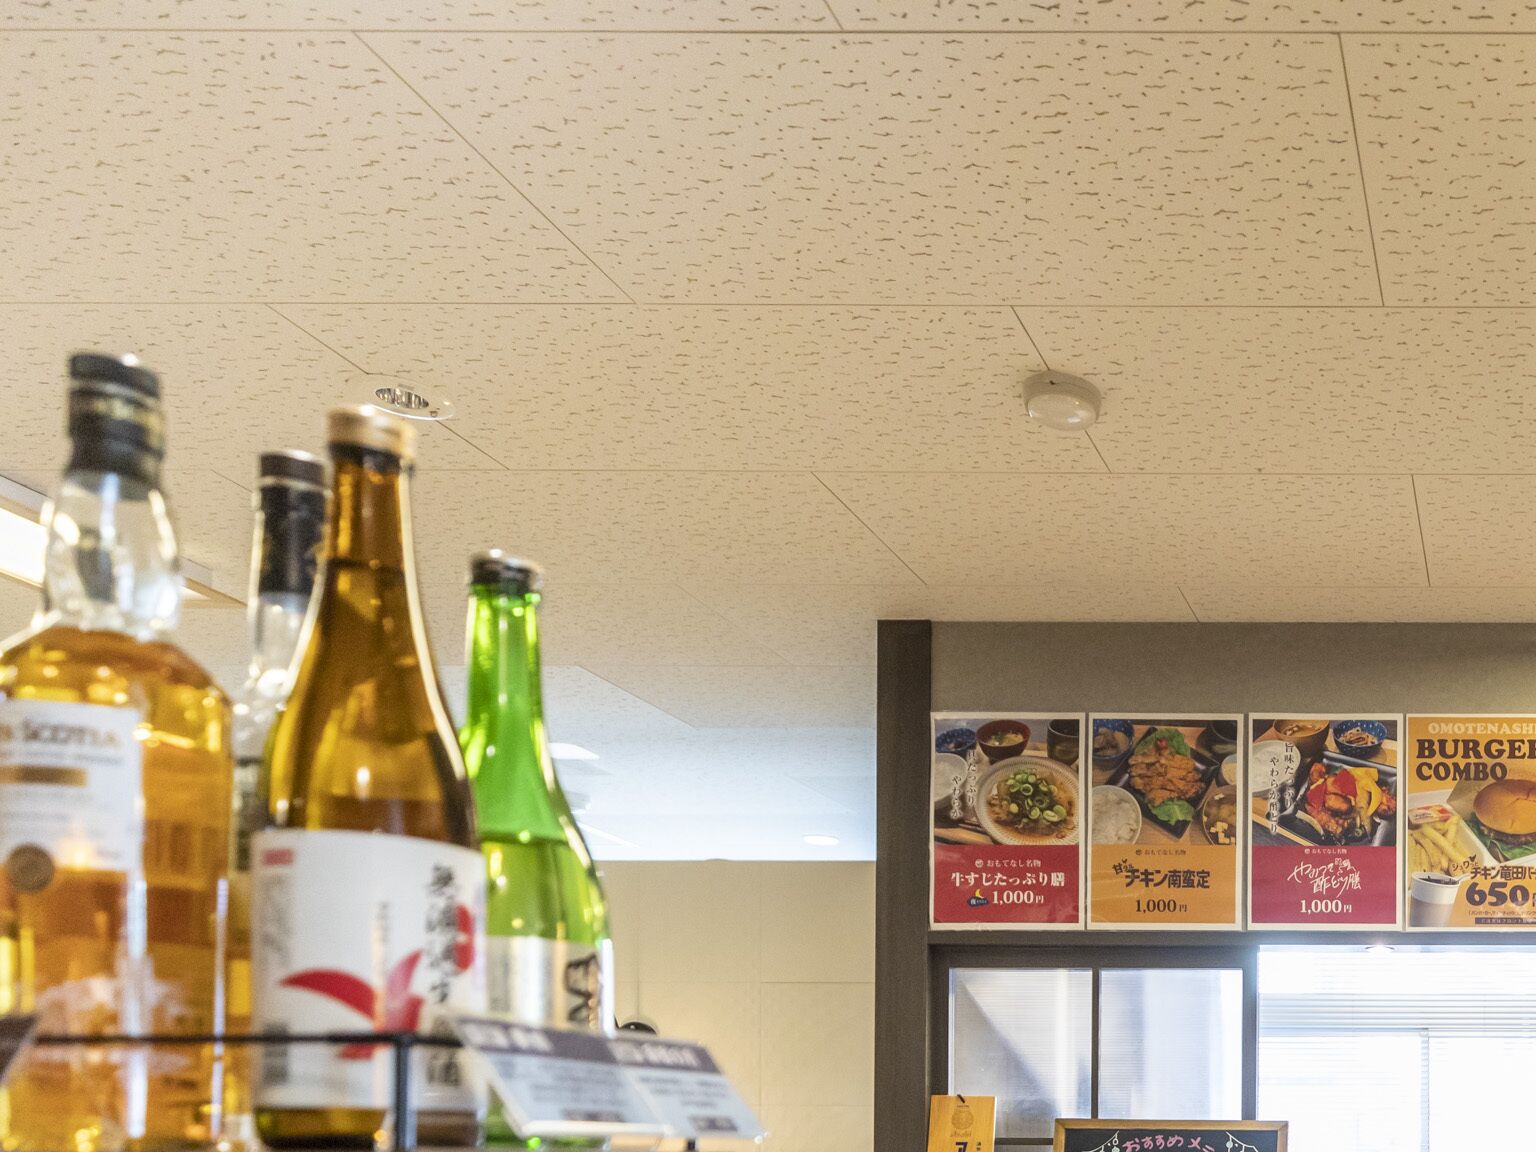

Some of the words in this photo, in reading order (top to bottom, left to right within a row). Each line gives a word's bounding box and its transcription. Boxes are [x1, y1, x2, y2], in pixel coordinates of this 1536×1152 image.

[1284, 742, 1295, 809] 旨味たっぷり
[1416, 762, 1508, 781] COMBO
[1269, 756, 1280, 833] やわらか酢どり
[986, 859, 1042, 868] おもてなし名物
[951, 872, 1065, 887] 牛すじたっぷり膳
[1125, 869, 1210, 888] チキン南蛮定
[992, 890, 1044, 905] 1,000円
[1135, 899, 1188, 913] 1,000円
[1299, 899, 1353, 915] 1,000円
